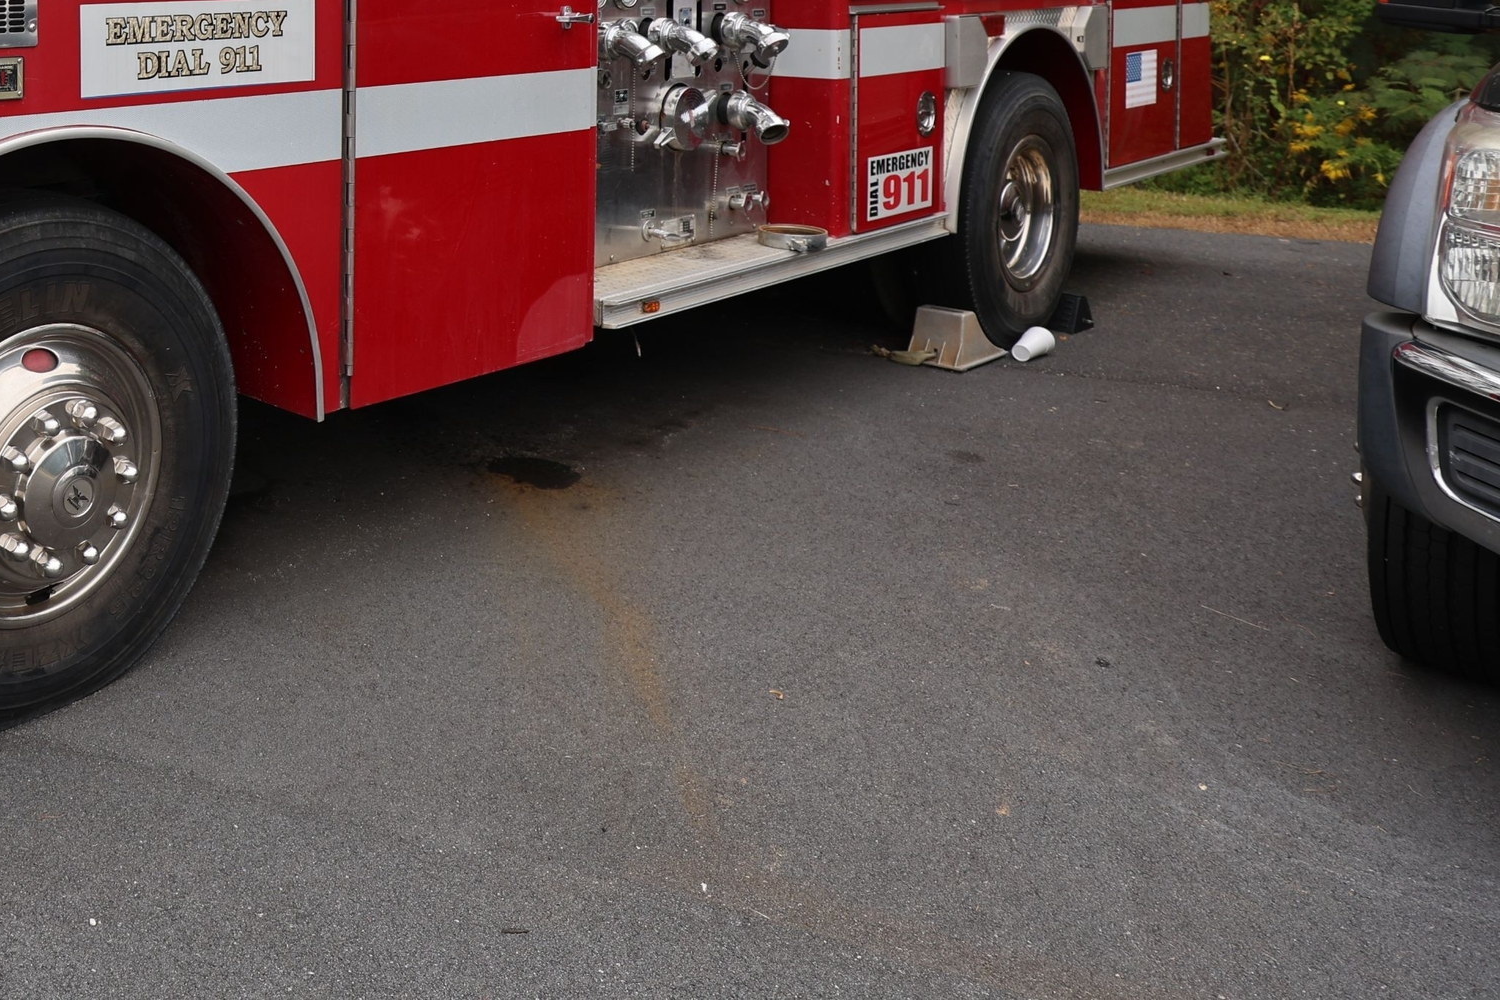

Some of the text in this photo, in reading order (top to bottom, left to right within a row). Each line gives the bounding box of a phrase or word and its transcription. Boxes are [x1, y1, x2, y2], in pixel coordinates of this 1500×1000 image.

[105, 10, 287, 46] EMERGENCY
[137, 45, 262, 80] DIAL 911
[870, 150, 930, 176] EMERGENCY
[869, 178, 879, 218] DIAL
[882, 168, 930, 211] 911
